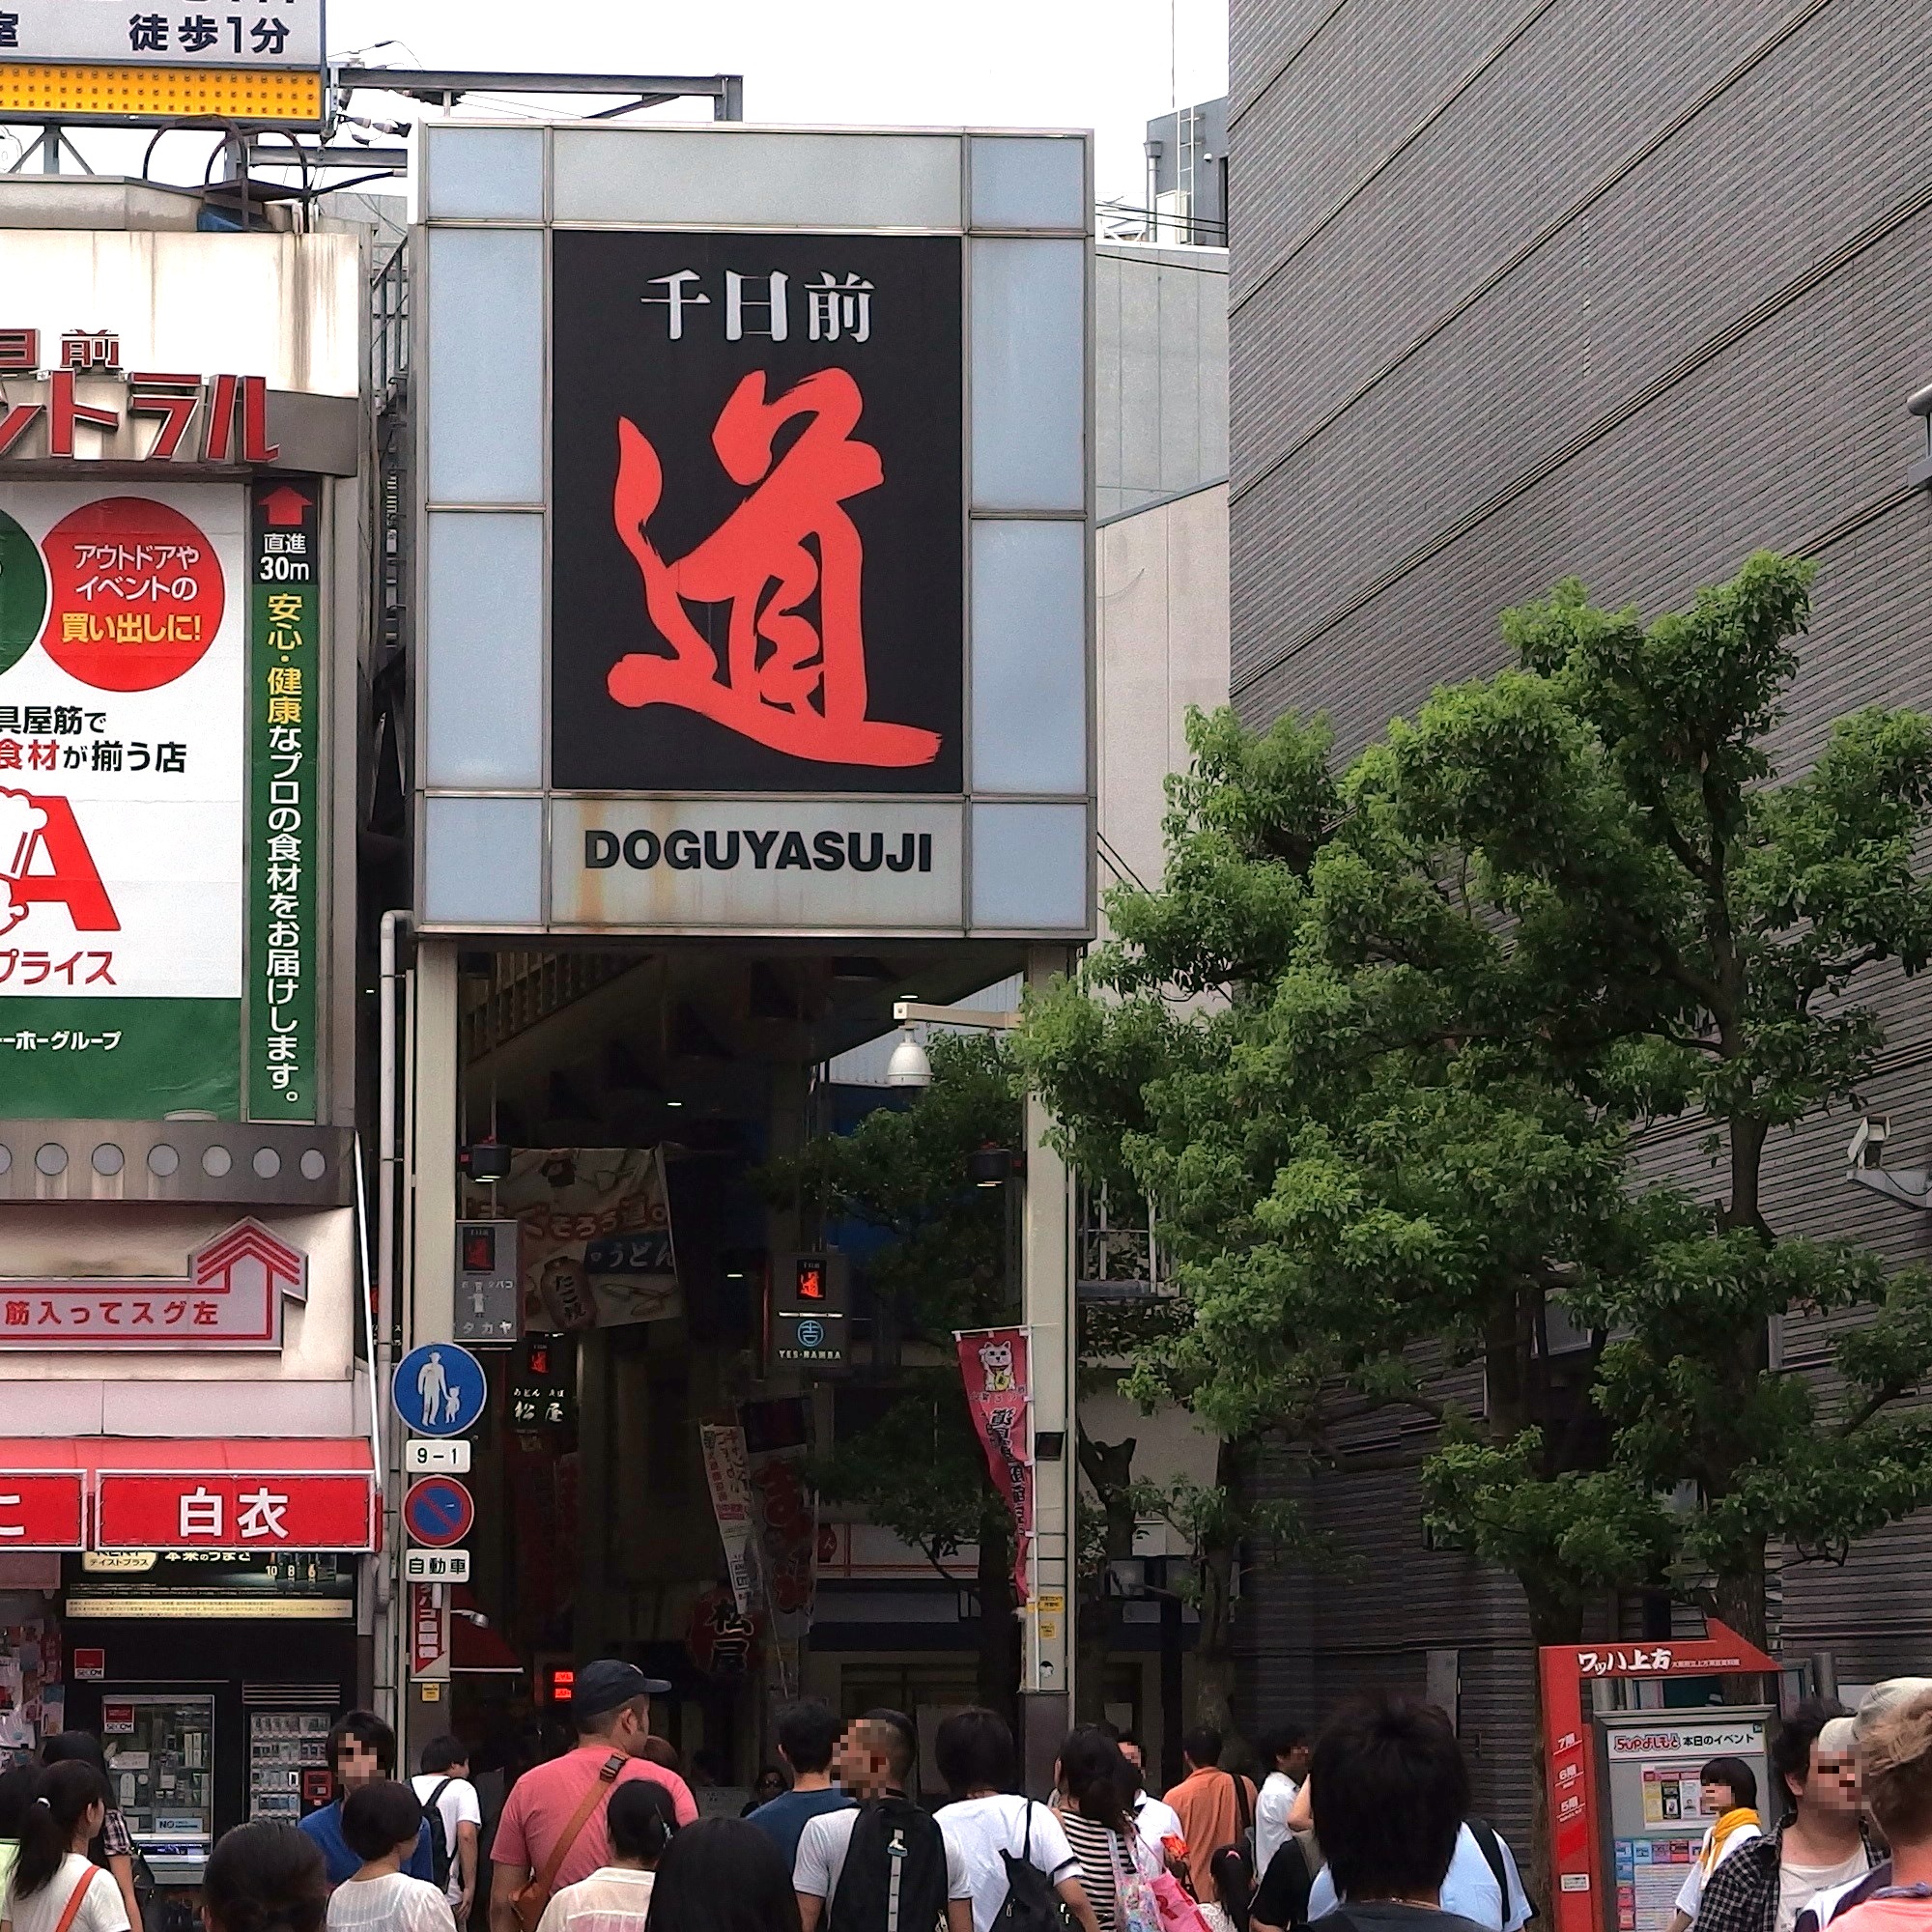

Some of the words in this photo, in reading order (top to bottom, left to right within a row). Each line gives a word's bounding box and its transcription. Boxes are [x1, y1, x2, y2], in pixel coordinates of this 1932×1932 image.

[128, 14, 291, 55] 徒歩1分
[640, 268, 876, 344] 千日前
[264, 532, 306, 554] 直進
[73, 544, 201, 572] アウトドアや
[259, 556, 310, 582] 30m
[607, 366, 944, 768] 道
[74, 575, 199, 602] イベントの
[0, 705, 107, 735] 具屋筋で
[0, 739, 187, 773] 食材が揃う店
[266, 592, 303, 1103] 安心・健康なプロの食材をお届けします。
[583, 829, 933, 873] DOGUYASUJI
[0, 1030, 123, 1051] ーホーグループ
[5, 1300, 219, 1326] 筋入ってスグ左
[416, 1447, 459, 1464] 9-1
[179, 1486, 289, 1540] 白衣
[266, 1565, 278, 1577] 10
[409, 1557, 467, 1575] 自動車
[1577, 1647, 1672, 1676] ワッハ上方
[1683, 1733, 1755, 1747] 本日のイベント
